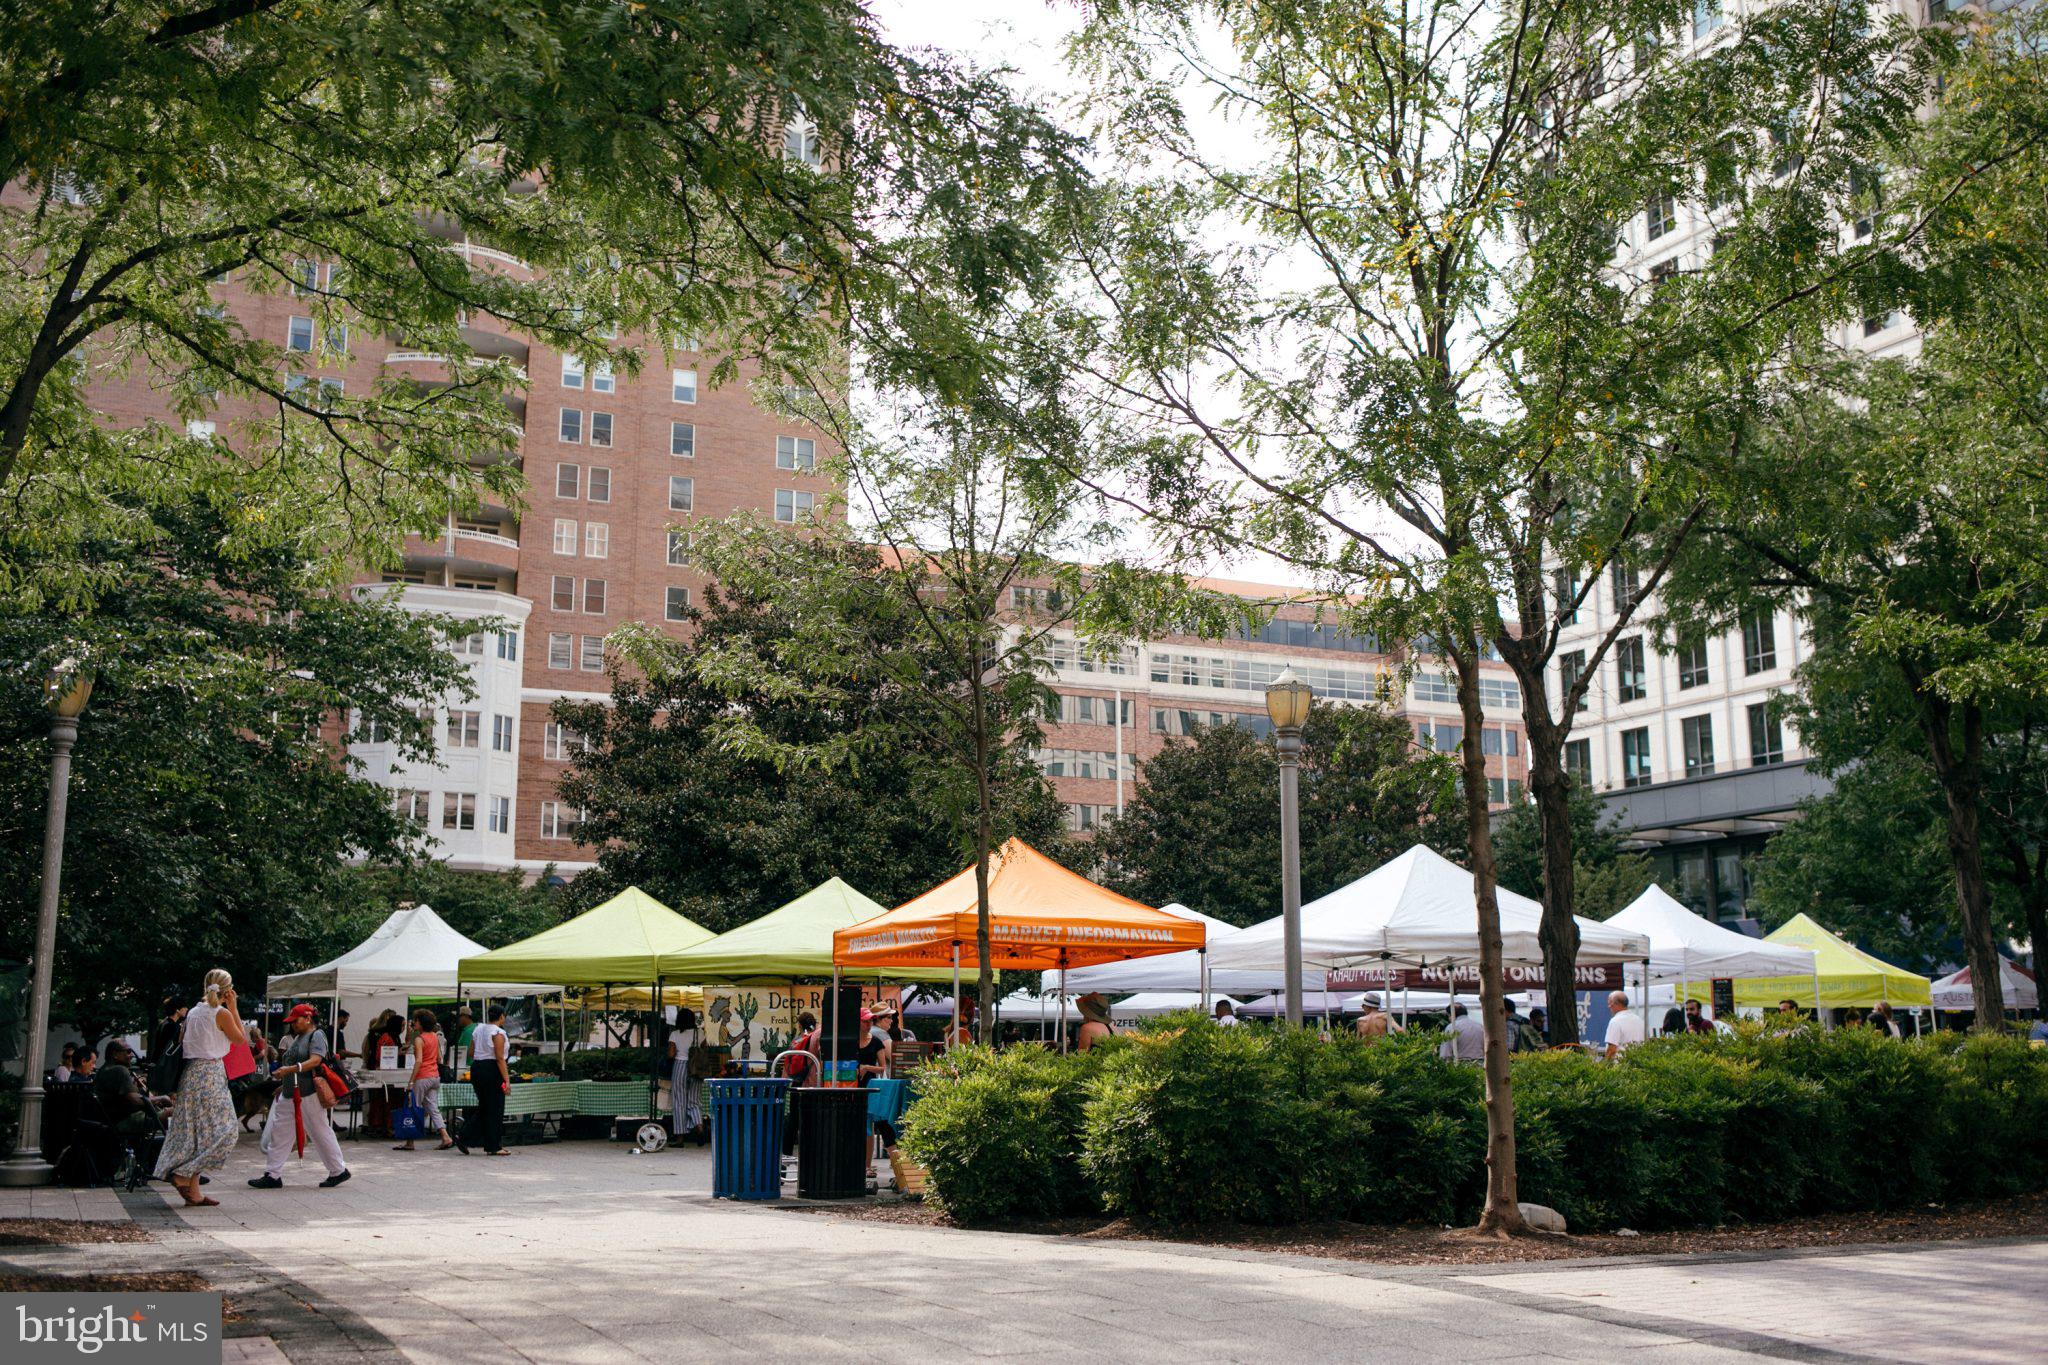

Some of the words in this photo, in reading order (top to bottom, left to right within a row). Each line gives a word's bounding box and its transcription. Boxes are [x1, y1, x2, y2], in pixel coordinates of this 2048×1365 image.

[991, 924, 1062, 942] MARKET
[1066, 926, 1174, 943] INFORMATION
[769, 991, 804, 1015] Deep
